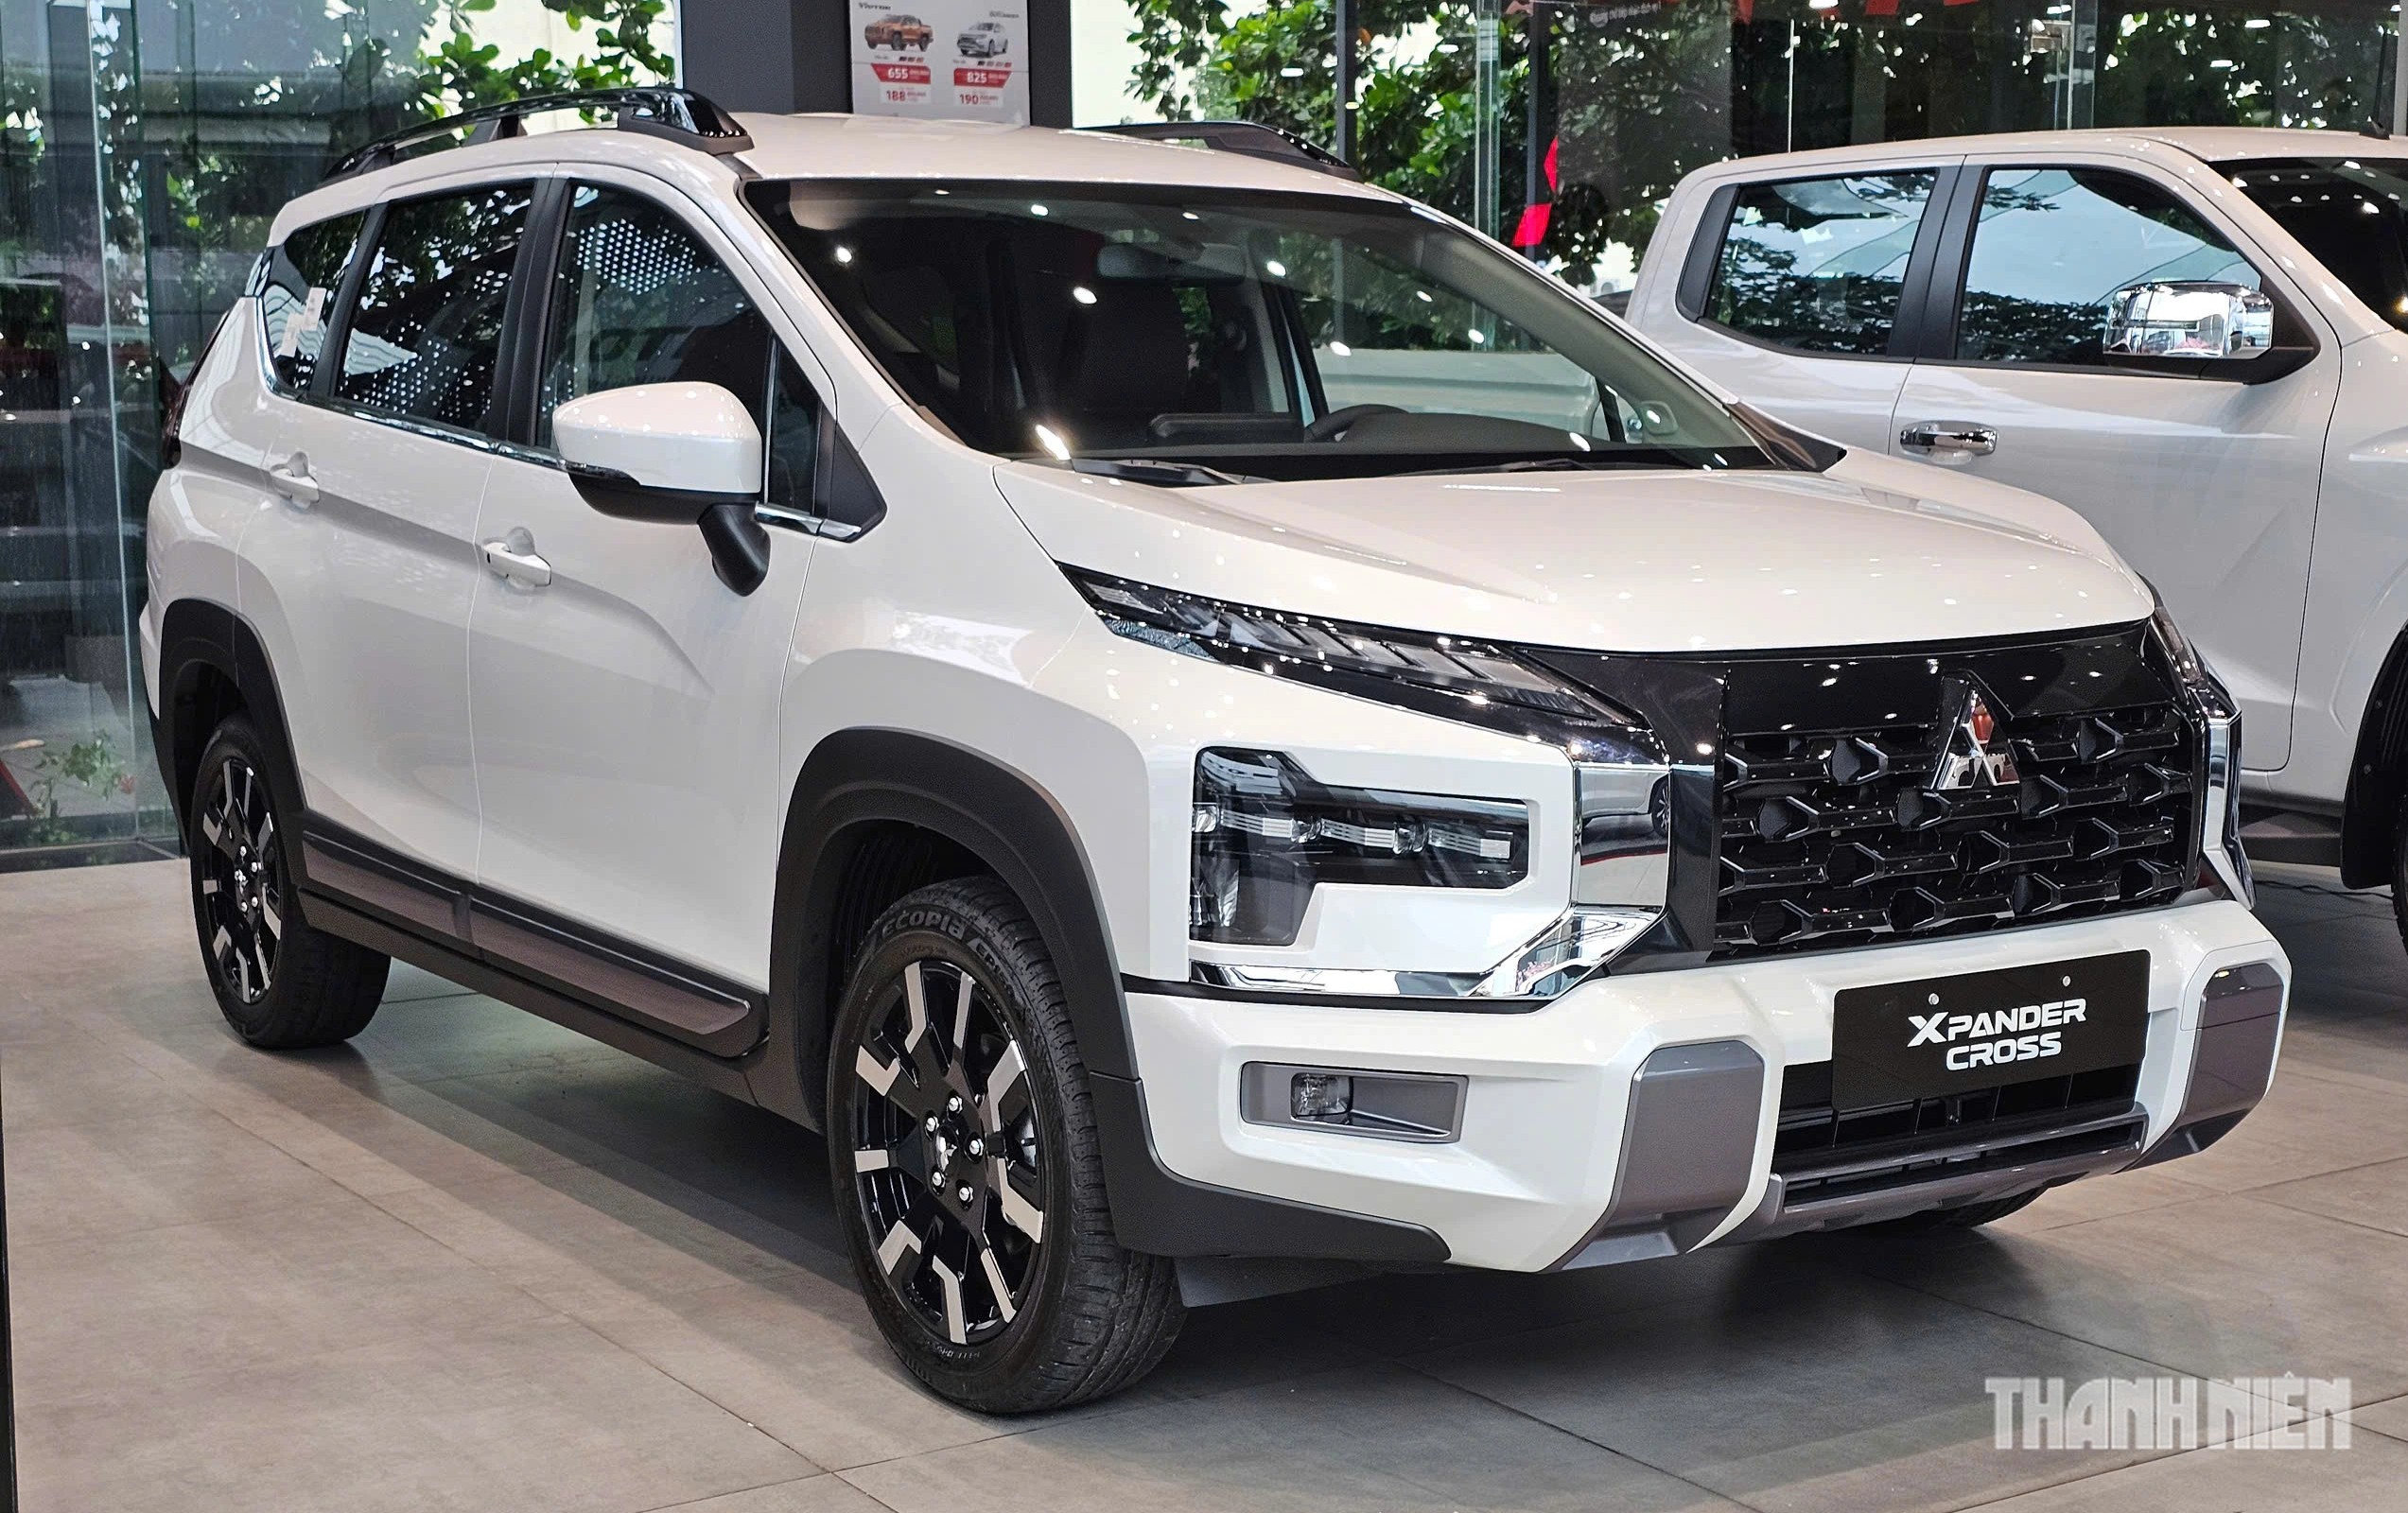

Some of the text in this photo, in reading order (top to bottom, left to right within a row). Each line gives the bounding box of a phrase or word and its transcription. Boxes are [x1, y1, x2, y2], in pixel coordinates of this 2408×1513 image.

[887, 67, 909, 79] 655
[967, 71, 987, 83] 825
[886, 90, 906, 101] 188
[959, 94, 979, 105] 190
[1907, 998, 2086, 1048] XPANDER
[1946, 1031, 2062, 1070] CROSS
